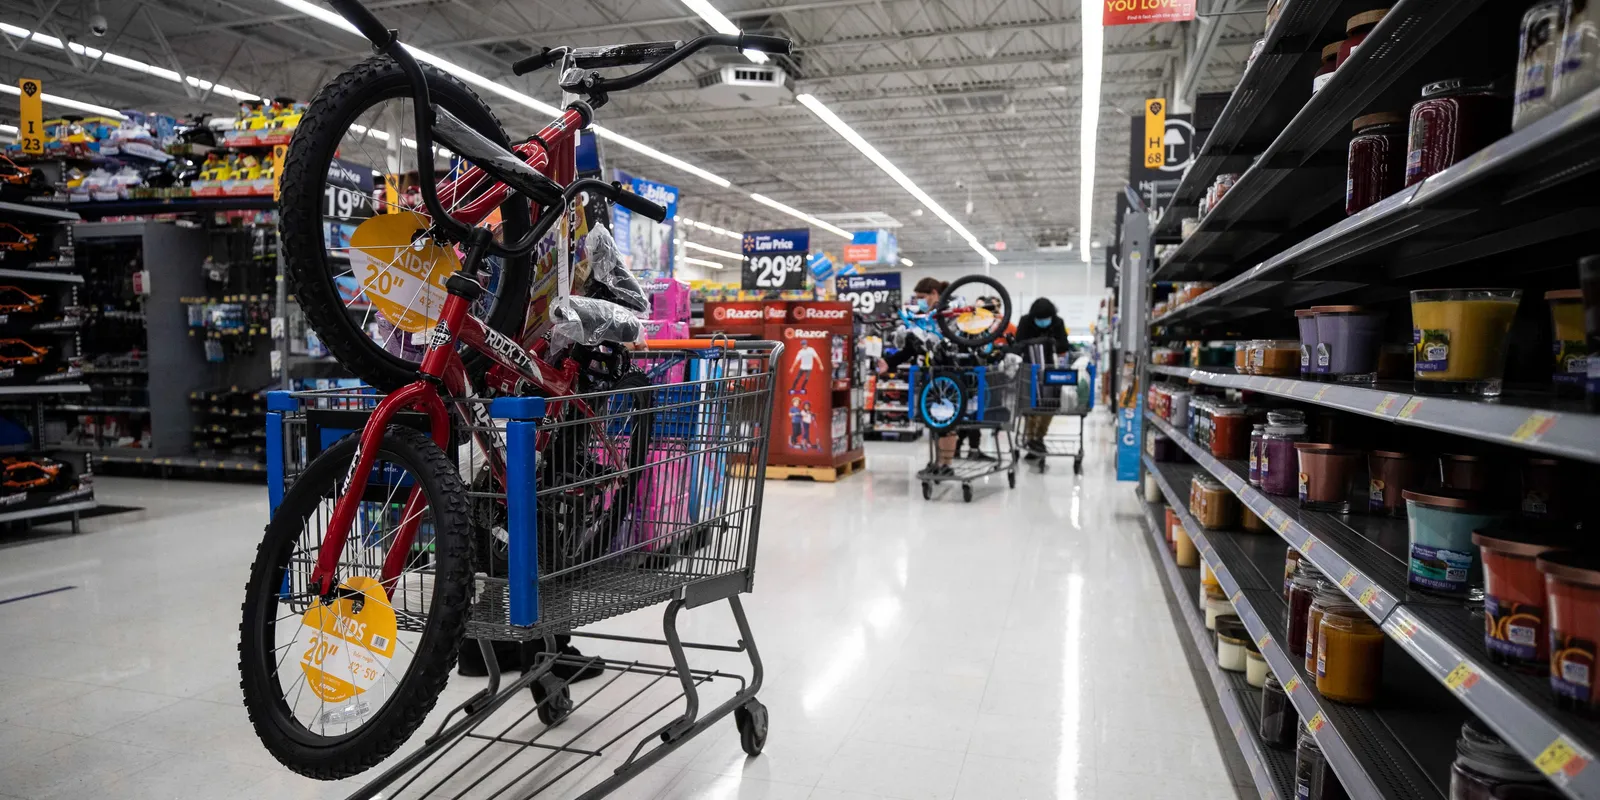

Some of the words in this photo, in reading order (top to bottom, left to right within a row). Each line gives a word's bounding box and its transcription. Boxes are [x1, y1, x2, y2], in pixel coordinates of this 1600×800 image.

[1108, 0, 1136, 12] YOU
[1142, 0, 1181, 9] LOVE.
[28, 121, 34, 134] I
[24, 138, 40, 150] 23
[1149, 137, 1160, 148] H
[1147, 153, 1162, 164] 68
[756, 240, 773, 250] Low
[773, 238, 794, 249] Price
[393, 247, 431, 278] KIDS
[806, 308, 848, 319] Razor
[795, 328, 829, 338] Razor
[485, 329, 515, 358] ROCK
[513, 353, 531, 367] IT
[333, 615, 367, 641] KIDS
